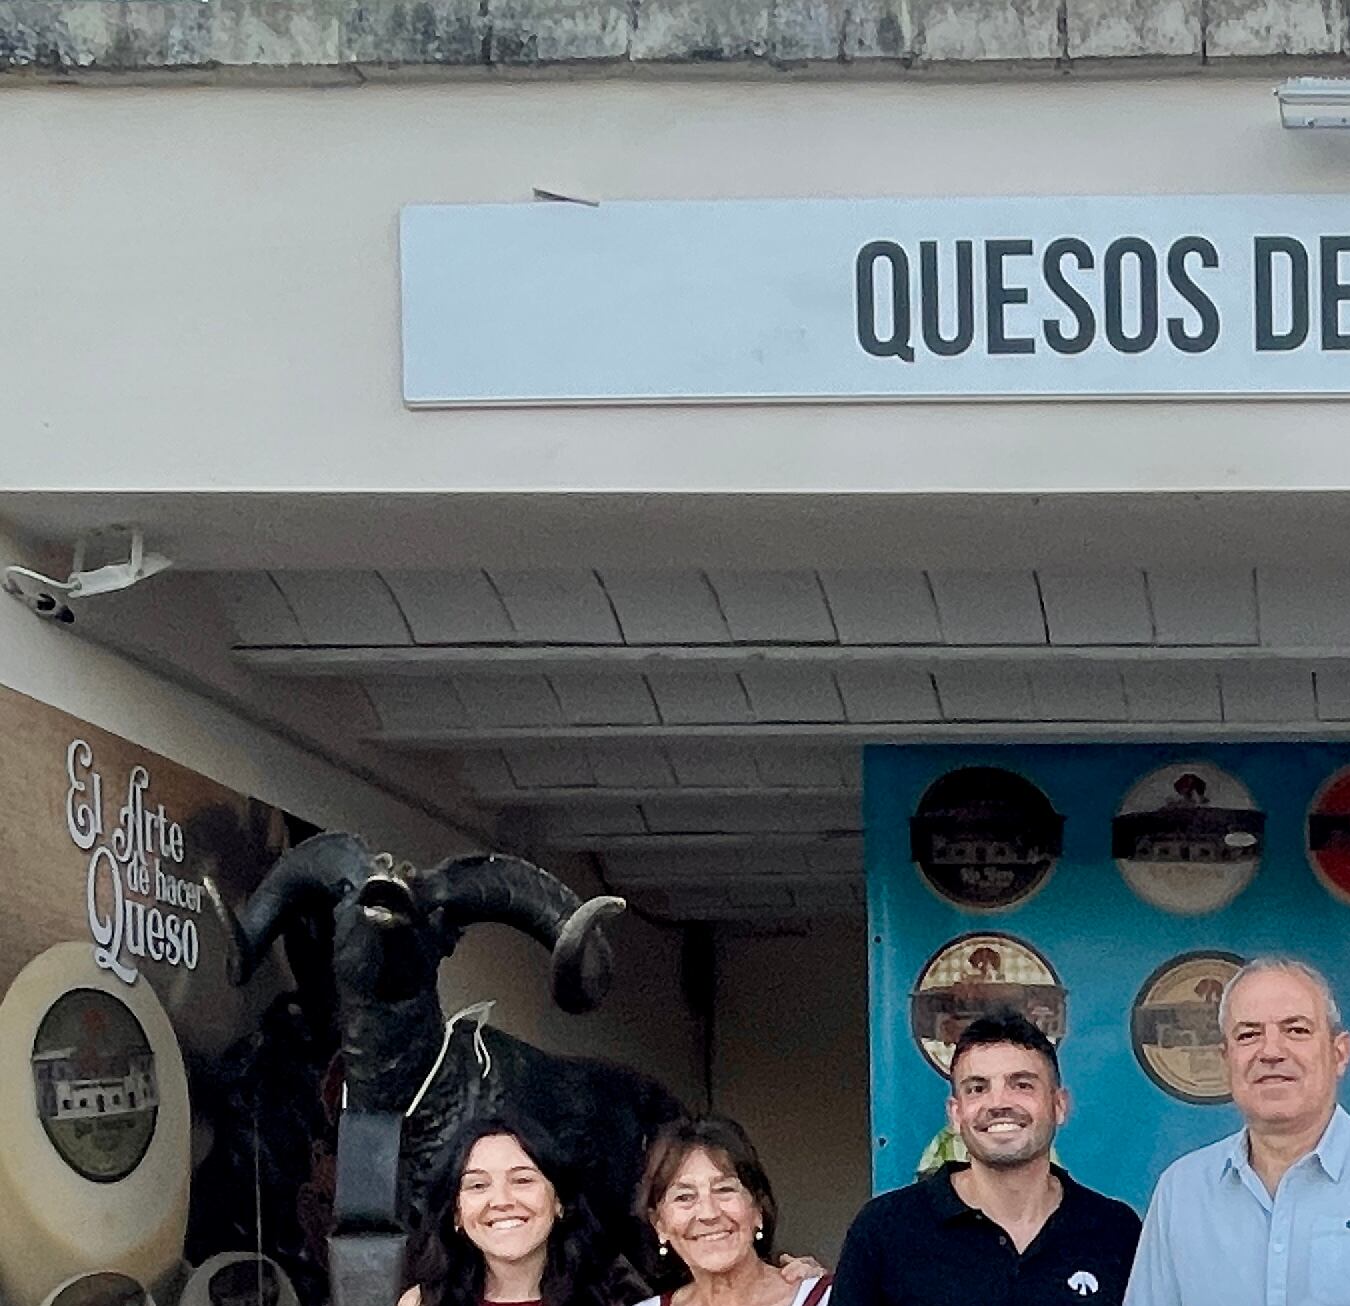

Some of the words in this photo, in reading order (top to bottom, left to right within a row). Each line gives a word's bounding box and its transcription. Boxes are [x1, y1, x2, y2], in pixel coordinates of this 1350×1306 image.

[855, 236, 1220, 363] QUESOS
[67, 739, 103, 849] El
[112, 765, 185, 865] Arte
[87, 845, 199, 984] Queso
[127, 850, 150, 894] de
[155, 858, 203, 913] hacer
